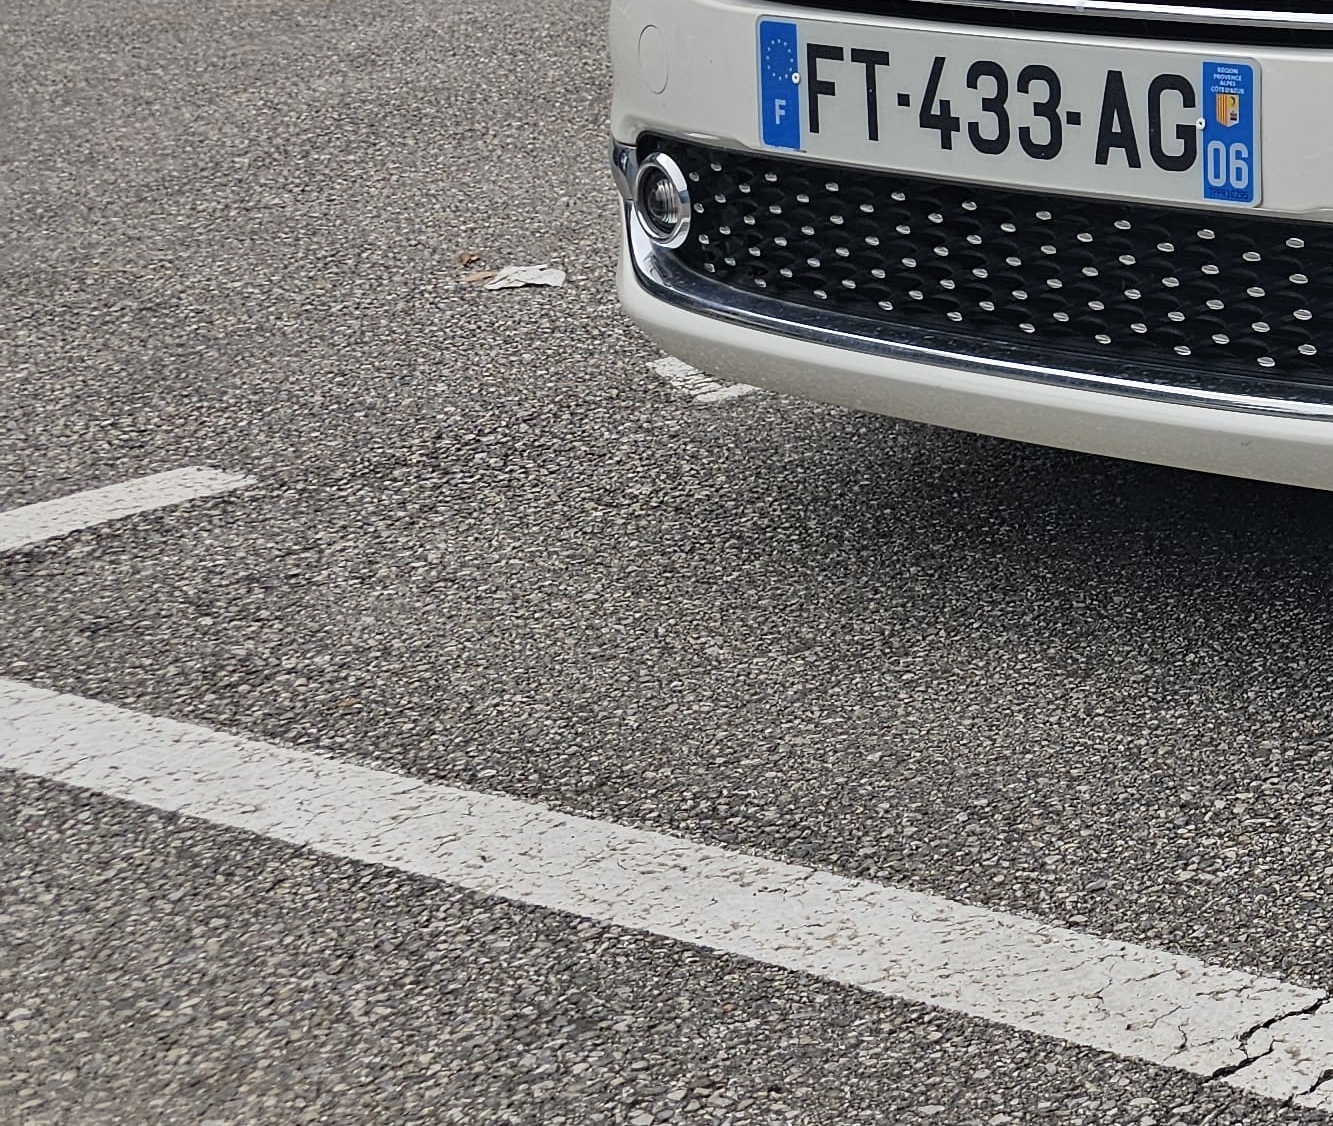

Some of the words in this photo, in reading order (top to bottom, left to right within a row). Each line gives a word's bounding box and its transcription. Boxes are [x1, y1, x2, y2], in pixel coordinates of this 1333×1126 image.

[774, 99, 787, 126] F
[806, 42, 1198, 172] FT-433-AG
[1207, 140, 1249, 189] 06
